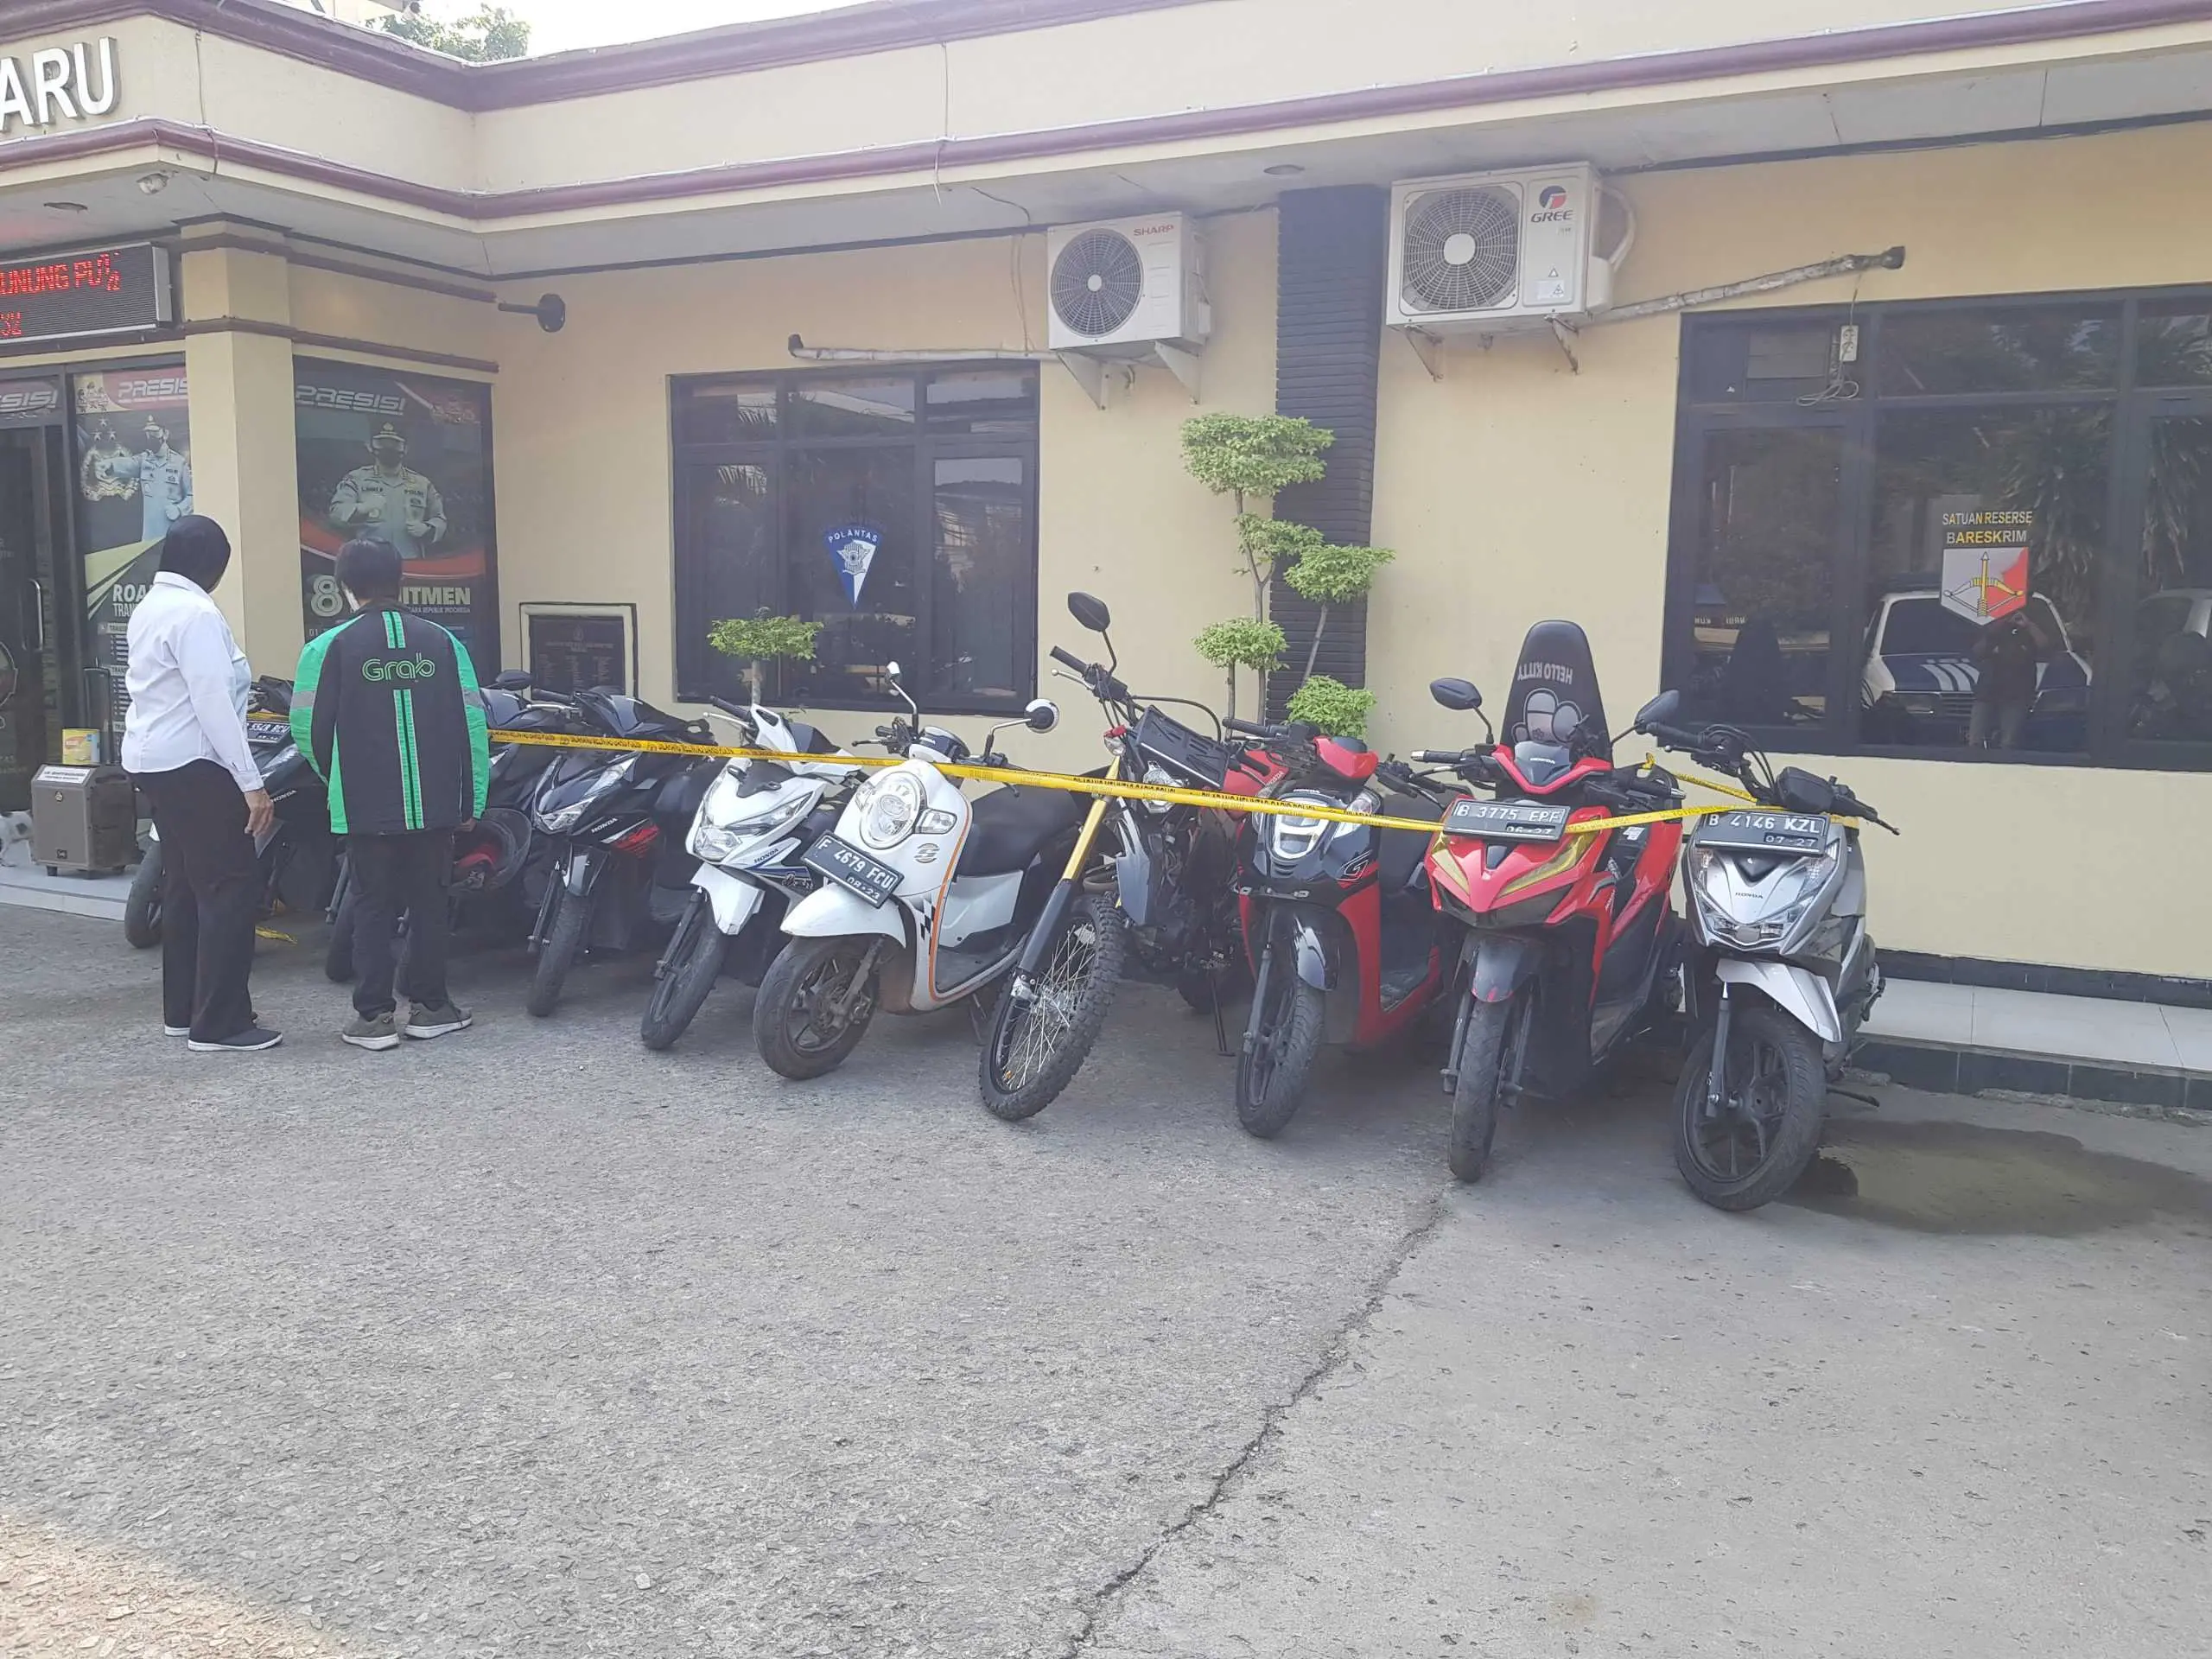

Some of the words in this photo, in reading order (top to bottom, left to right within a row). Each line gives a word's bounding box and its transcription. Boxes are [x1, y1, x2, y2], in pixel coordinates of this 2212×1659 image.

[0, 37, 115, 130] ARU
[1530, 210, 1573, 222] GREE
[1133, 224, 1174, 236] SHARP
[1942, 512, 1983, 525] SATUAN
[1985, 511, 2033, 525] RESERSE
[828, 529, 878, 543] POLANTAS
[1946, 530, 2027, 544] BARESKRIM
[113, 584, 153, 602] ROA
[398, 587, 471, 605] ITMEN
[362, 652, 435, 682] Grab
[1457, 804, 1470, 817] B
[1476, 806, 1519, 820] 3775
[591, 817, 618, 834] HONDA
[1708, 814, 1719, 826] B
[1731, 815, 1775, 830] 4146
[1783, 817, 1821, 834] KZL
[753, 848, 779, 863] HONDA
[817, 838, 832, 850] F
[833, 849, 866, 873] 4679
[866, 867, 895, 890] FCU
